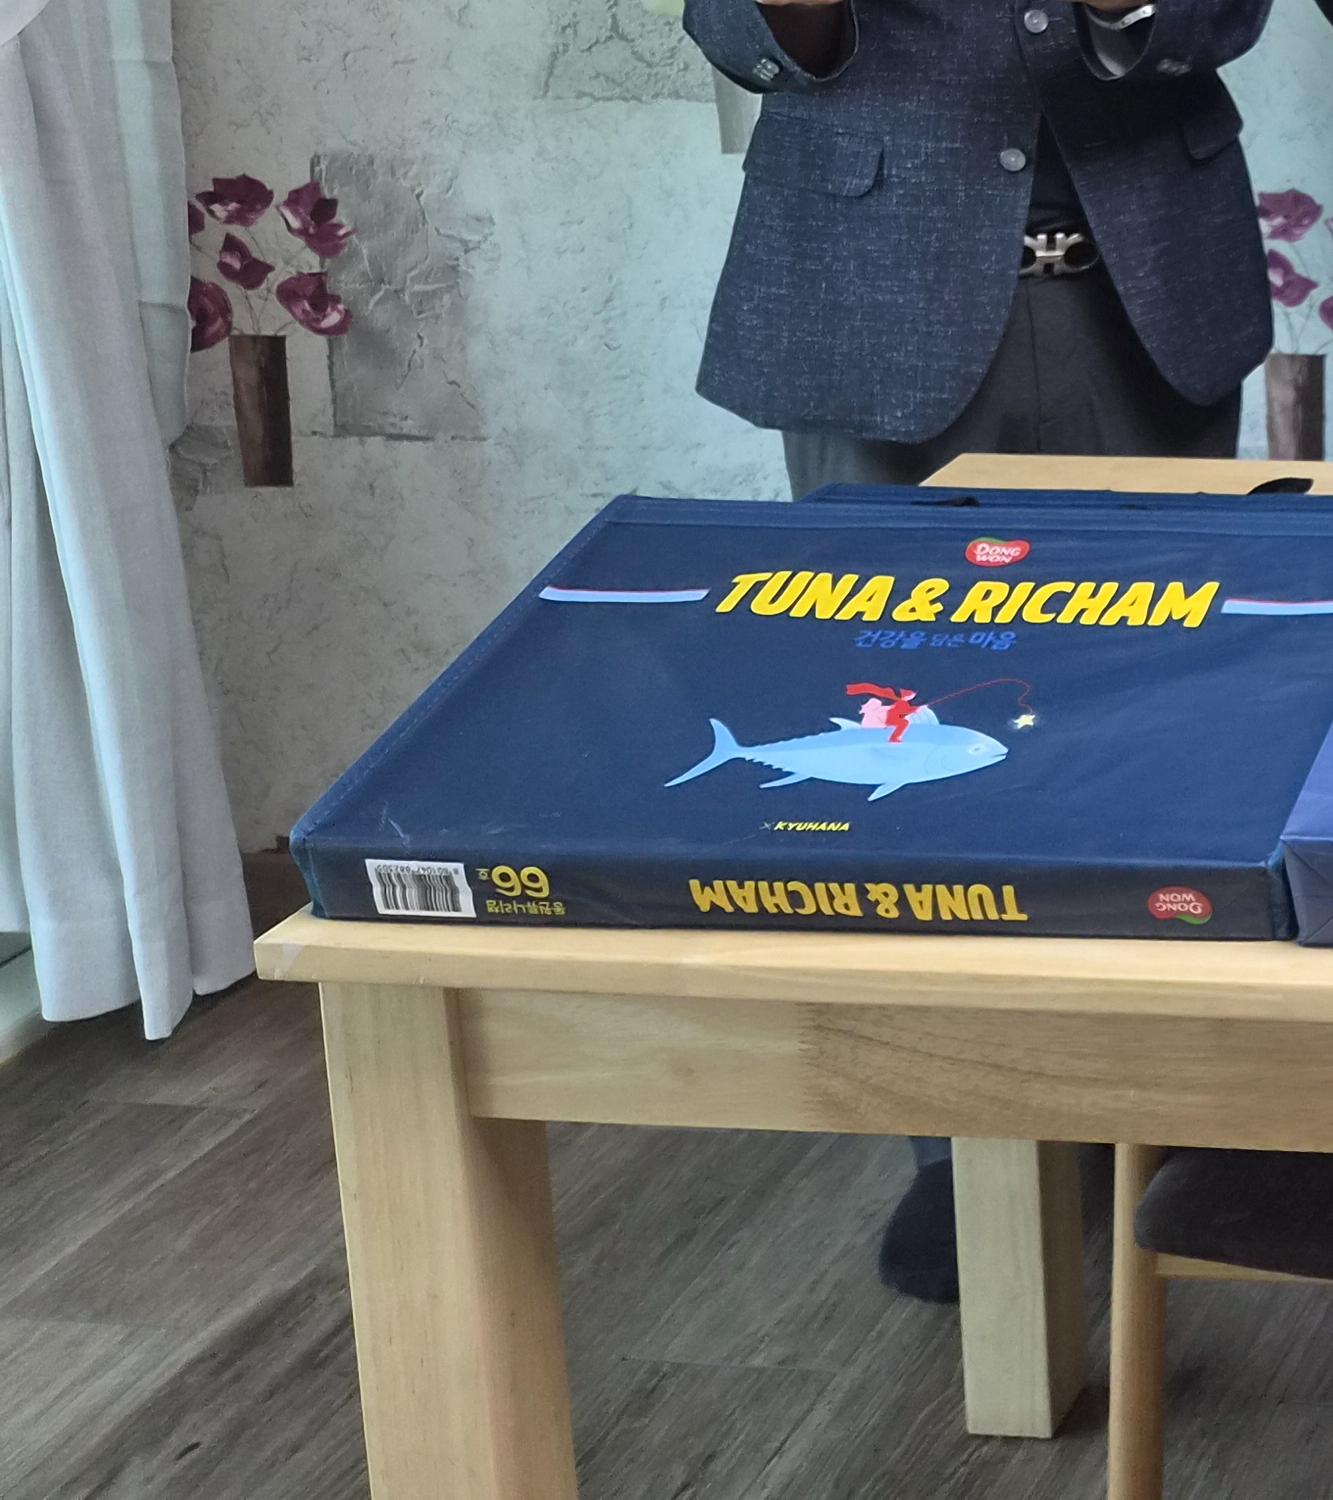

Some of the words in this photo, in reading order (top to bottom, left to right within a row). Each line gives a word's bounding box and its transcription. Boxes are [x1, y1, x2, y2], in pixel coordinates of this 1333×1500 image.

[974, 543, 1021, 557] DONG
[976, 555, 1012, 564] WON
[716, 571, 895, 621] TUNA
[892, 578, 949, 622] &
[950, 581, 1220, 627] RICHAM
[854, 629, 927, 649] 건강을
[968, 630, 1016, 650] 마음
[774, 821, 850, 832] KYUHANA
[689, 879, 863, 917] RICHAM
[865, 883, 899, 918] &
[903, 884, 1029, 921] TUNA
[1159, 893, 1196, 902] WON
[1155, 902, 1203, 914] DONG
